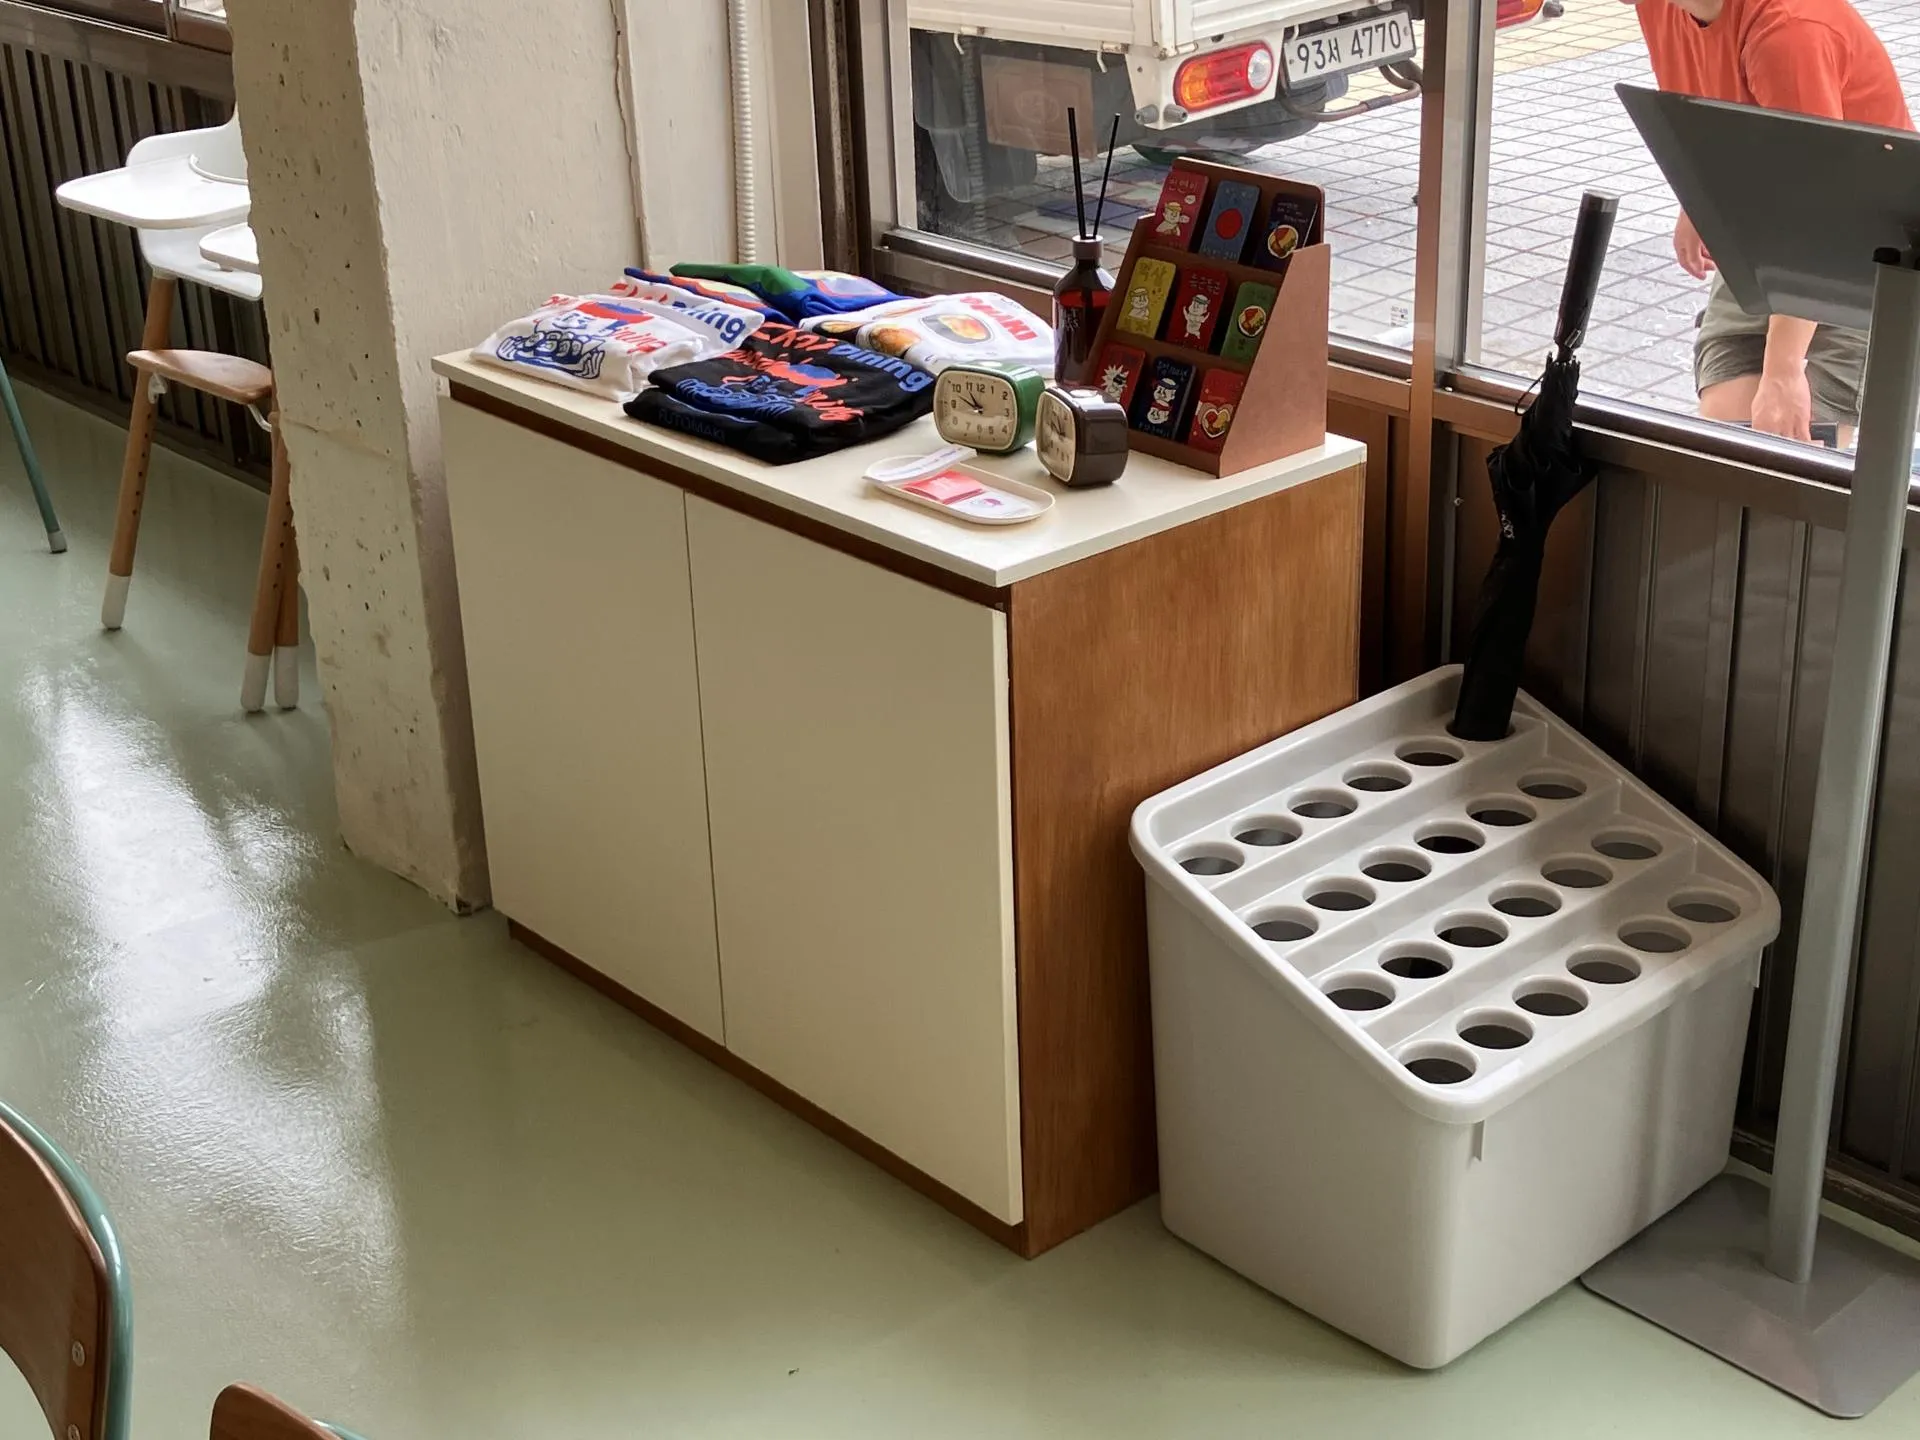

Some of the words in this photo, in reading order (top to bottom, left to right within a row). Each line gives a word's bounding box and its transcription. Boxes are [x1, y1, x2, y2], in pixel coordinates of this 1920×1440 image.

[1297, 37, 1341, 73] 93서
[1351, 20, 1401, 59] 4770
[827, 343, 934, 392] Dining
[658, 408, 726, 440] FUTOMAKI
